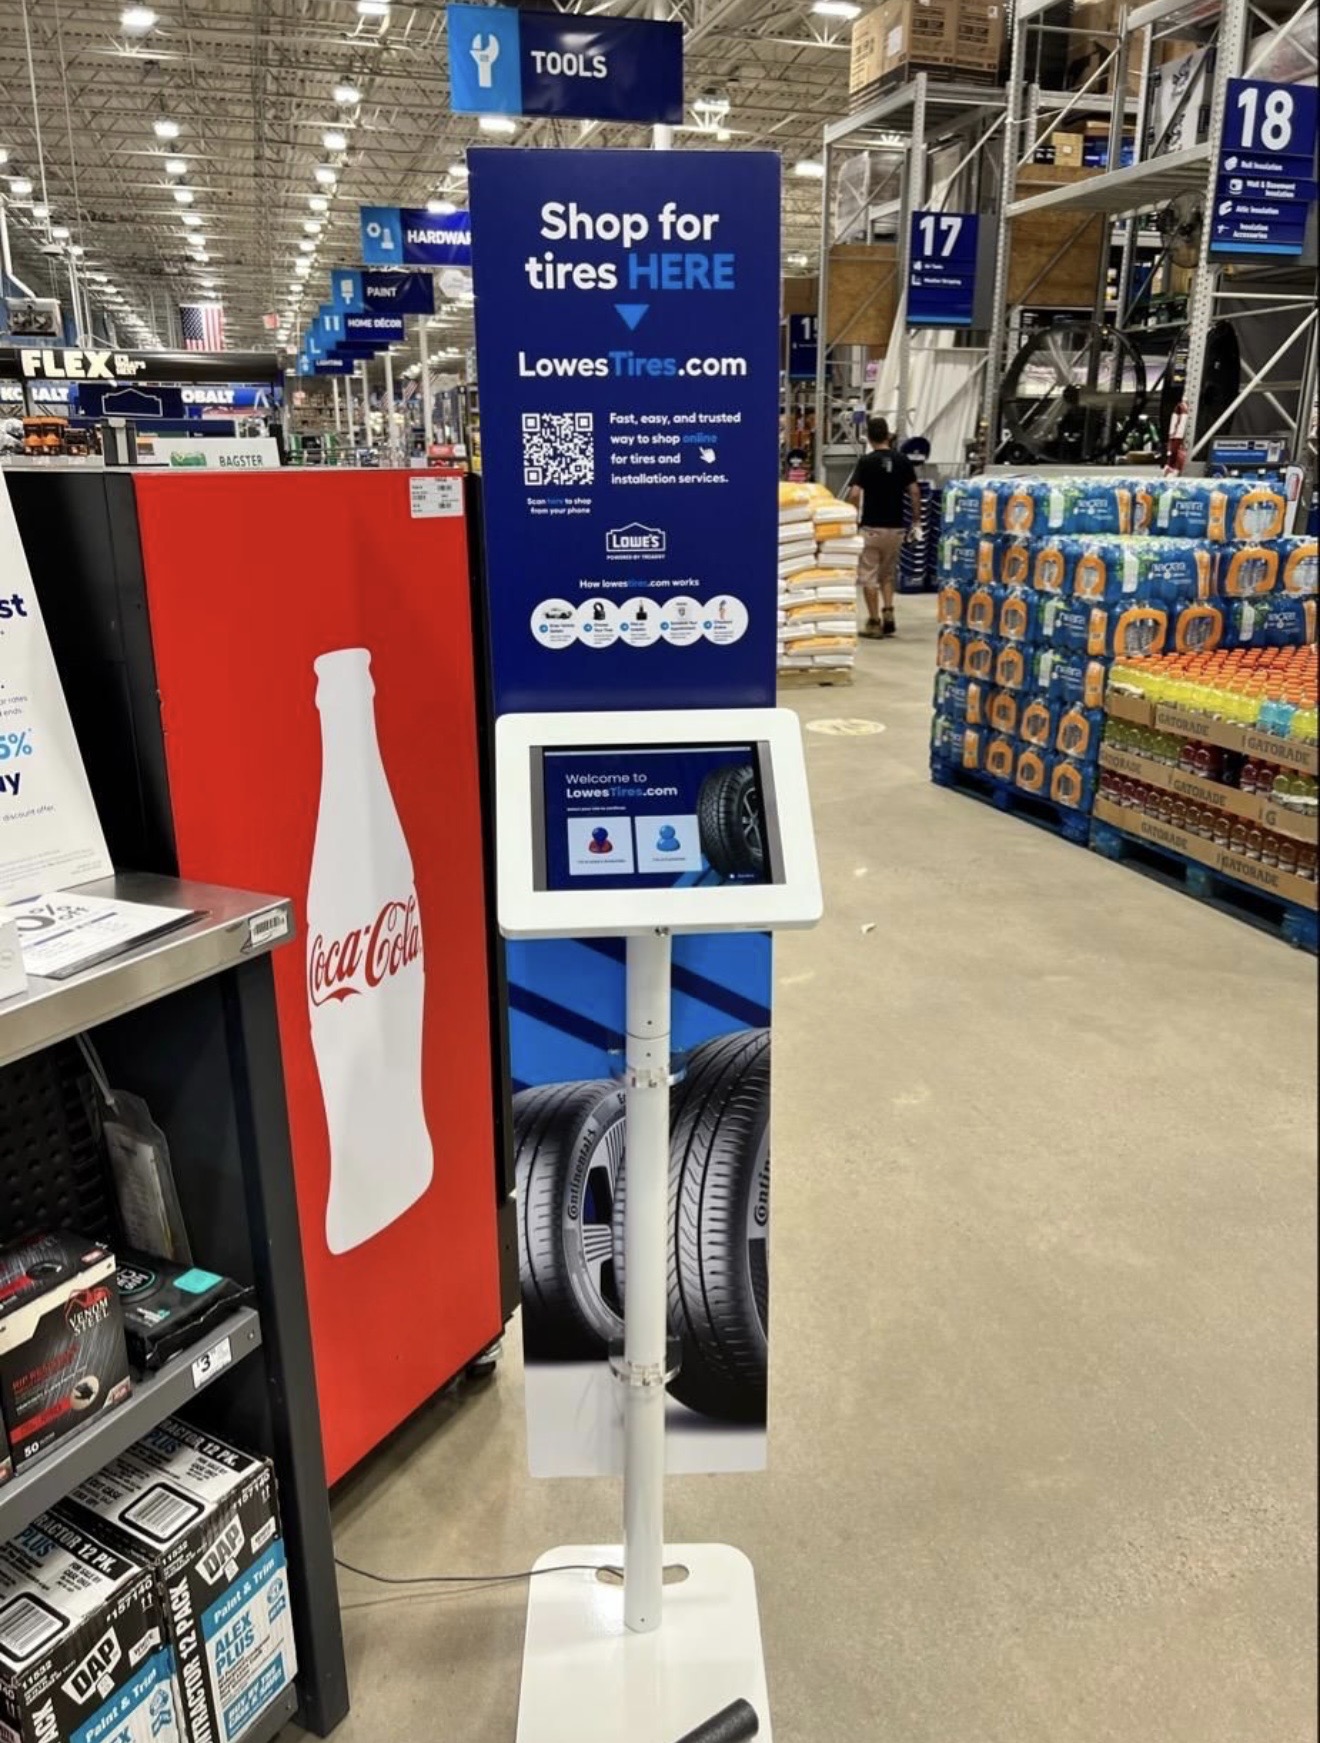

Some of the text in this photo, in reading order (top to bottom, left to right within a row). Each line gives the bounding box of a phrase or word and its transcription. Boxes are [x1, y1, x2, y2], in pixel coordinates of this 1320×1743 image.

[531, 50, 607, 78] TOOLS
[1238, 87, 1294, 150] 18
[540, 202, 719, 248] Shop for
[919, 215, 962, 257] 17
[525, 252, 736, 290] tires HERE
[367, 286, 397, 297] PAINT
[348, 317, 402, 328] HOME DÉCOR
[21, 351, 114, 379] FLEX
[518, 350, 747, 377] LowesTires.com
[609, 412, 741, 425] Fast, easy, and trusted
[610, 432, 717, 446] way to shop online
[219, 453, 264, 468] BAGSTER
[611, 453, 681, 465] for tires and
[611, 473, 729, 484] installation services.
[549, 508, 566, 516] your
[567, 507, 590, 515] phone
[574, 498, 591, 506] shop
[612, 533, 659, 548] LOWE'S
[579, 579, 600, 589] How
[672, 578, 699, 587] works
[1158, 713, 1210, 736] GATORADE
[1248, 736, 1310, 764] GATORADE
[565, 772, 647, 785] Welcome to
[566, 785, 677, 799] LowesTires.com
[1173, 779, 1226, 806] GATORADE
[1141, 821, 1188, 850] GATORADE
[1222, 855, 1279, 888] GATORADE
[309, 895, 422, 1006] Coca-Cola
[568, 1133, 594, 1221] Continental
[69, 1297, 108, 1328] VENOM
[73, 1311, 110, 1337] STEEL
[24, 1441, 39, 1458] 50
[150, 1429, 182, 1455] PLUS
[202, 1440, 220, 1456] 12
[216, 1450, 237, 1467] PK.
[15, 1526, 55, 1558] PLUS
[203, 1523, 240, 1580] DAP
[78, 1542, 97, 1560] 12
[91, 1554, 117, 1574] PK.
[213, 1560, 275, 1624] Paint & Trim
[169, 1575, 196, 1638] PACK
[180, 1629, 198, 1660] 12
[214, 1610, 254, 1661] ALEX
[71, 1636, 116, 1697] DAP
[216, 1629, 255, 1678] PLUS
[86, 1668, 157, 1743] Paint & Trim
